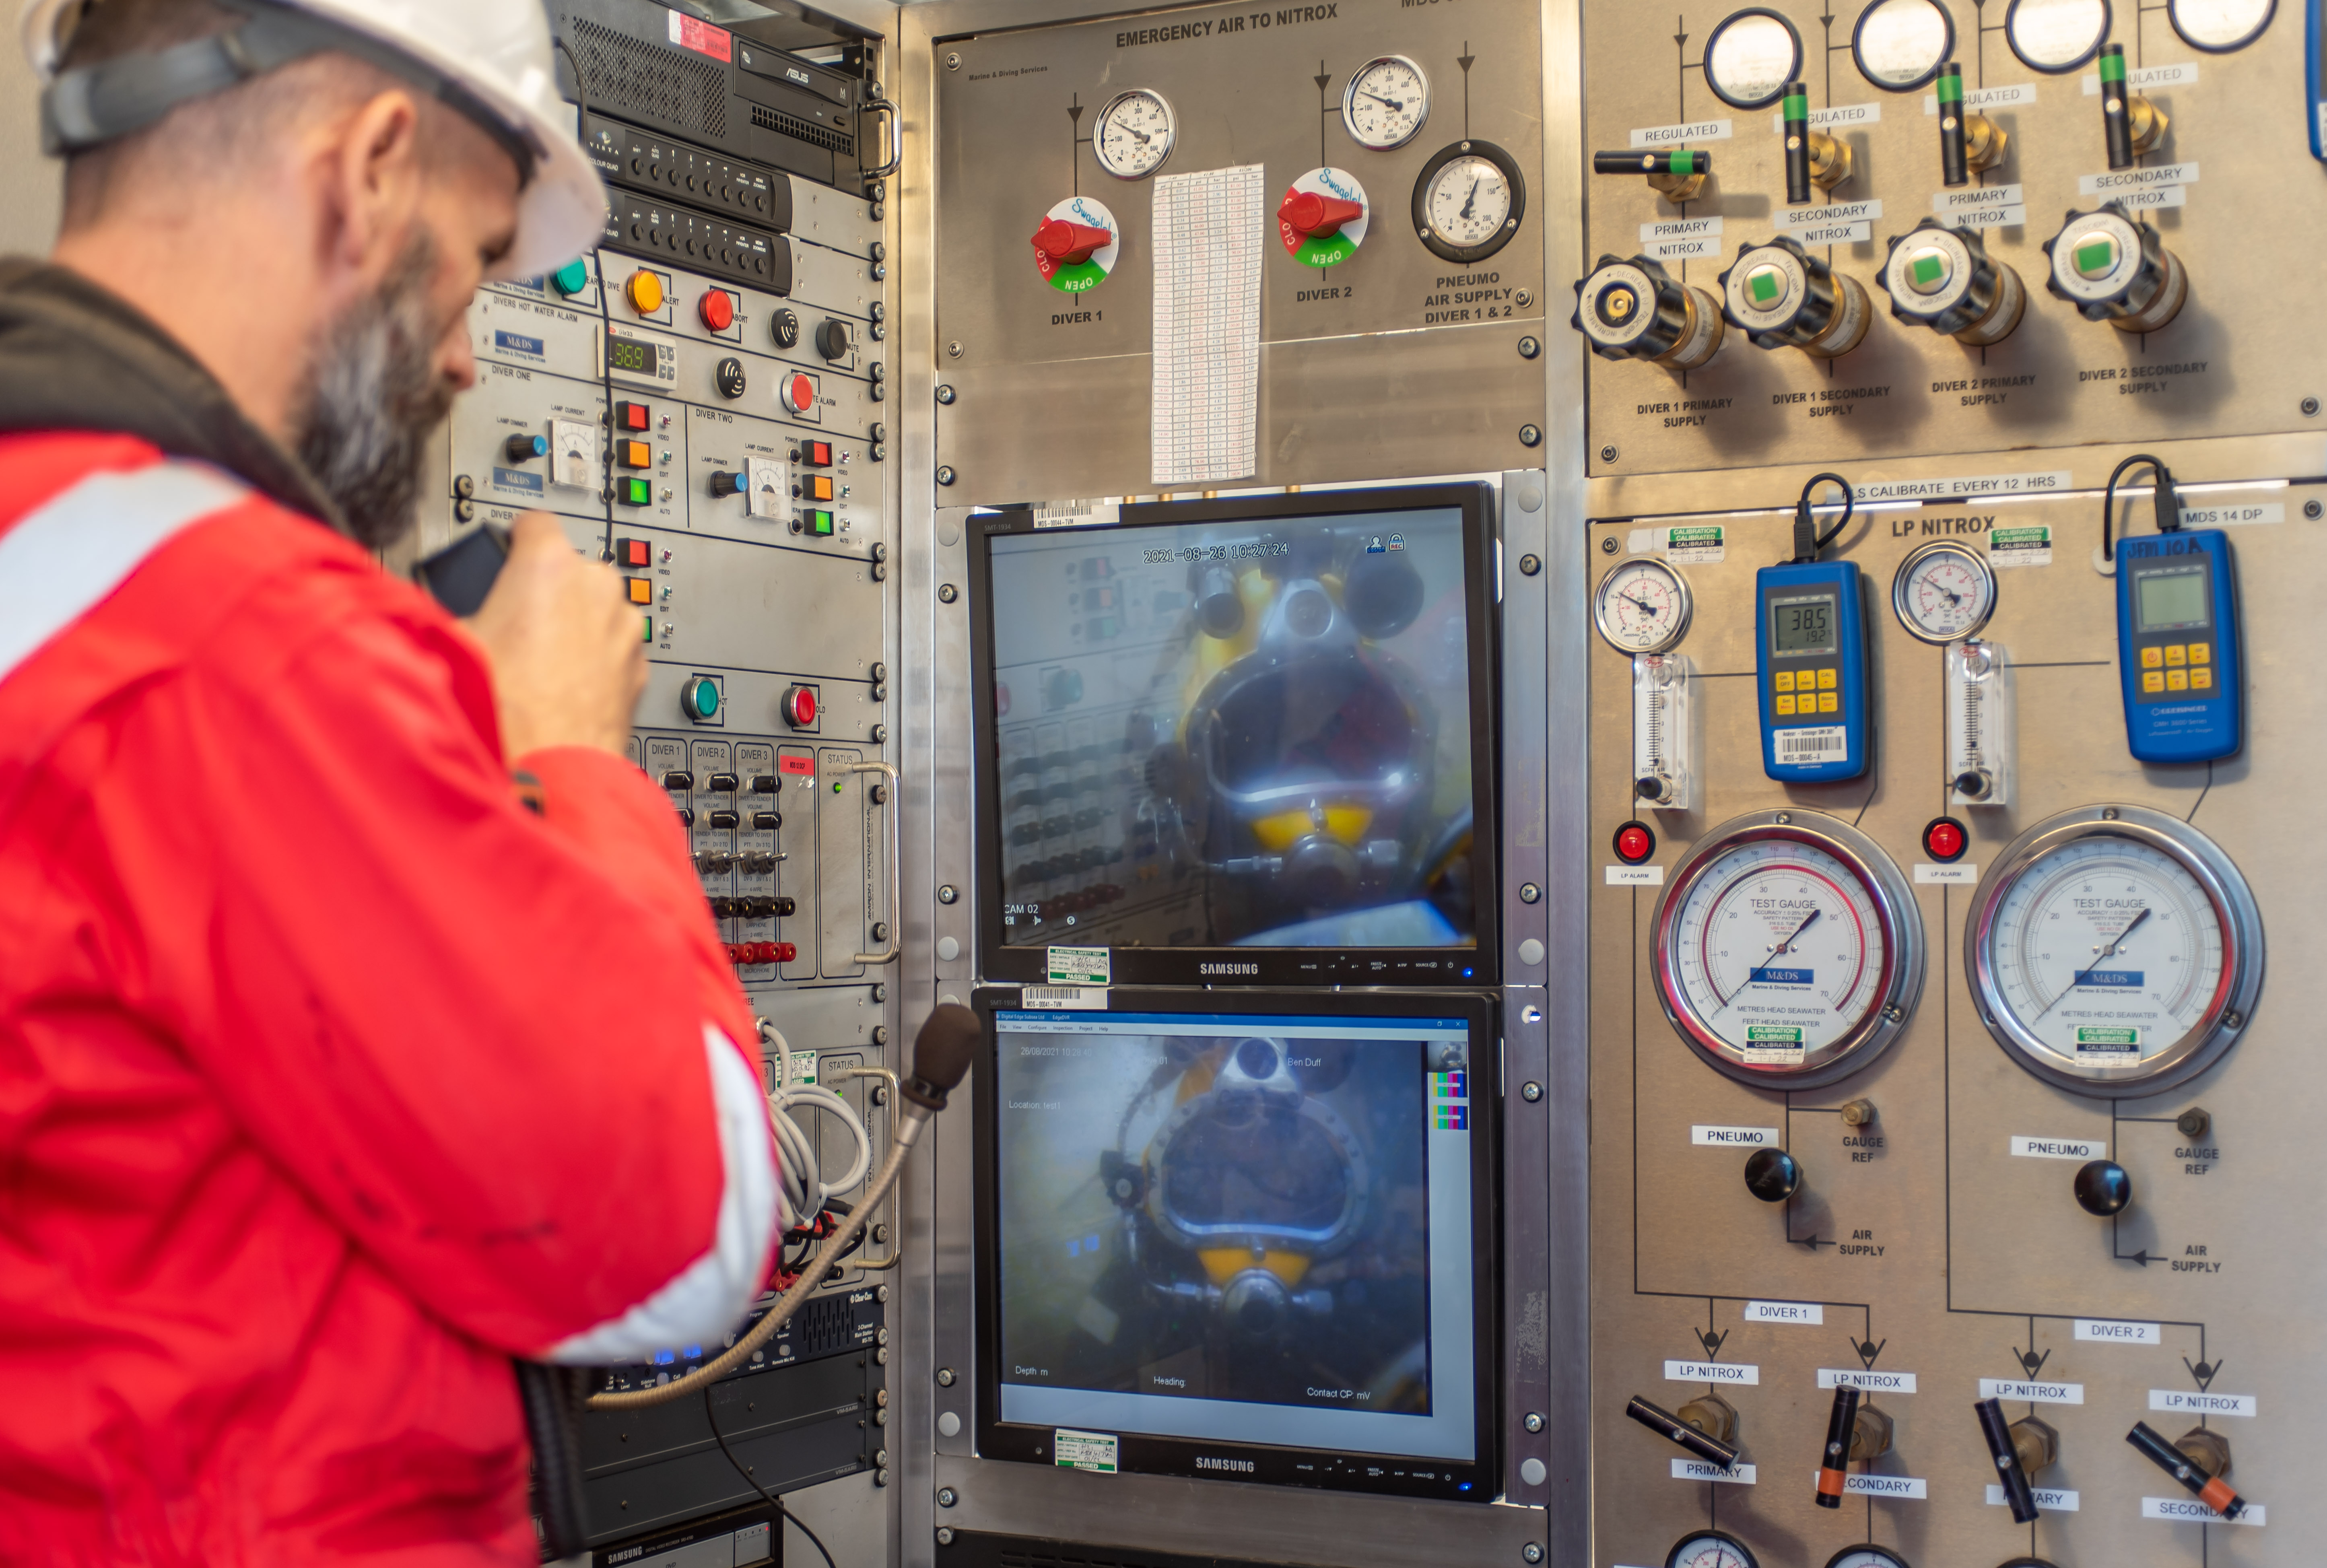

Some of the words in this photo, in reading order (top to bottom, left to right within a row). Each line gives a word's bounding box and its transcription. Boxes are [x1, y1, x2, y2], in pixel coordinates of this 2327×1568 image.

[1116, 21, 1213, 47] EMERGENCY
[1218, 16, 1245, 34] AIR
[1249, 12, 1271, 29] TO
[1277, 3, 1338, 26] NITROX
[786, 68, 808, 83] ASUS
[969, 72, 989, 80] Marine
[999, 69, 1018, 77] Diving
[1020, 65, 1048, 75] Services
[1646, 124, 1718, 142] REGULATED
[589, 142, 619, 155] VISTA
[589, 157, 606, 168] COLOUR
[607, 161, 618, 171] QUAD
[2096, 167, 2183, 188] SECONDARY
[1949, 189, 2008, 206] PRIMARY
[2115, 191, 2166, 206] NITROX
[1789, 205, 1868, 223] SECONDARY
[1958, 210, 2007, 224] NITROX
[1655, 220, 1709, 236] PRIMARY
[1805, 227, 1852, 242] NITROX
[1659, 241, 1704, 255] NITROX
[1312, 250, 1342, 264] OPEN
[608, 282, 620, 291] DIVE
[1065, 277, 1093, 290] OPEN
[1436, 272, 1500, 289] PNEUMO
[662, 295, 679, 306] ALERT
[1297, 287, 1340, 302] DIVER
[1344, 286, 1352, 297] 2
[1424, 294, 1450, 307] AIR
[1455, 288, 1513, 304] SUPPLY
[494, 296, 515, 308] DIVERS
[519, 301, 530, 311] HOT
[534, 305, 554, 318] WATER
[557, 311, 577, 323] ALARM
[1425, 309, 1470, 323] DIVER
[1474, 308, 1482, 319] 1
[1487, 307, 1499, 319] &
[1503, 305, 1512, 317] 2
[1052, 312, 1091, 325] DIVER
[1096, 310, 1102, 321] 1
[507, 335, 532, 350] M&DS
[847, 343, 859, 352] MUTE
[492, 365, 513, 377] DIVER
[516, 370, 531, 381] ONE
[2079, 369, 2117, 381] DIVER
[2119, 367, 2127, 379] 2
[2131, 361, 2208, 378] SECONDARY
[2119, 381, 2168, 396] SUPPLY
[820, 397, 836, 406] ALARM
[1637, 403, 1670, 414] DIVER
[1674, 402, 1679, 412] 1
[1682, 398, 1733, 411] PRIMARY
[696, 409, 715, 420] DIVER
[718, 413, 733, 423] TWO
[1663, 415, 1707, 428] SUPPLY
[757, 445, 774, 453] CURRENT
[1870, 482, 1945, 498] CALIBRATE
[1953, 480, 1999, 493] EVERY
[2003, 478, 2019, 490] 12
[2027, 476, 2056, 488] HRS
[2186, 511, 2220, 523] MDS
[2223, 510, 2238, 521] 14
[2242, 508, 2263, 519] DP
[1892, 521, 1915, 537] LP
[1922, 516, 1996, 536] NITROX
[1143, 547, 1226, 564] 2021-08-26
[1231, 542, 1289, 559] 10:27:24
[1792, 608, 1826, 630] 38.5
[1806, 630, 1826, 643] 19.2
[652, 744, 673, 756] DIVER
[676, 747, 680, 756] 1
[697, 747, 719, 758] DIVER
[720, 749, 725, 758] 2
[741, 750, 761, 760] DIVER
[763, 752, 768, 760] 3
[828, 754, 853, 765] STATUS
[1027, 905, 1038, 914] 02
[1750, 899, 1777, 908] TEST
[1780, 899, 1816, 909] GAUGE
[1200, 963, 1258, 975] SAMSUNG
[1766, 971, 1798, 981] M&DS
[1288, 1058, 1303, 1067] Ben
[1305, 1058, 1322, 1068] Duff
[1009, 1100, 1041, 1109] Location:
[1707, 1130, 1763, 1144] PNEUMO
[1842, 1136, 1884, 1148] GAUGE
[2028, 1141, 2089, 1157] PNEUMO
[1851, 1152, 1874, 1163] REF
[1852, 1229, 1872, 1241] AIR
[1839, 1245, 1885, 1257] SUPPLY
[1760, 1306, 1797, 1319] DIVER
[1802, 1308, 1808, 1319] 1
[2091, 1324, 2133, 1338] DIVER
[2137, 1327, 2145, 1339] 2
[1015, 1366, 1037, 1376] Depth
[1680, 1365, 1694, 1376] LP
[1698, 1367, 1744, 1379] NITROX
[1154, 1376, 1186, 1389] Heading:
[1834, 1373, 1849, 1385] LP
[1853, 1375, 1901, 1388] NITROX
[1307, 1387, 1338, 1399] Contact
[1357, 1391, 1371, 1401] mV
[2166, 1395, 2183, 1407] LP
[2187, 1397, 2240, 1410] NITROX
[1196, 1457, 1254, 1473] SAMSUNG
[608, 1546, 642, 1564] SAMSUNG
